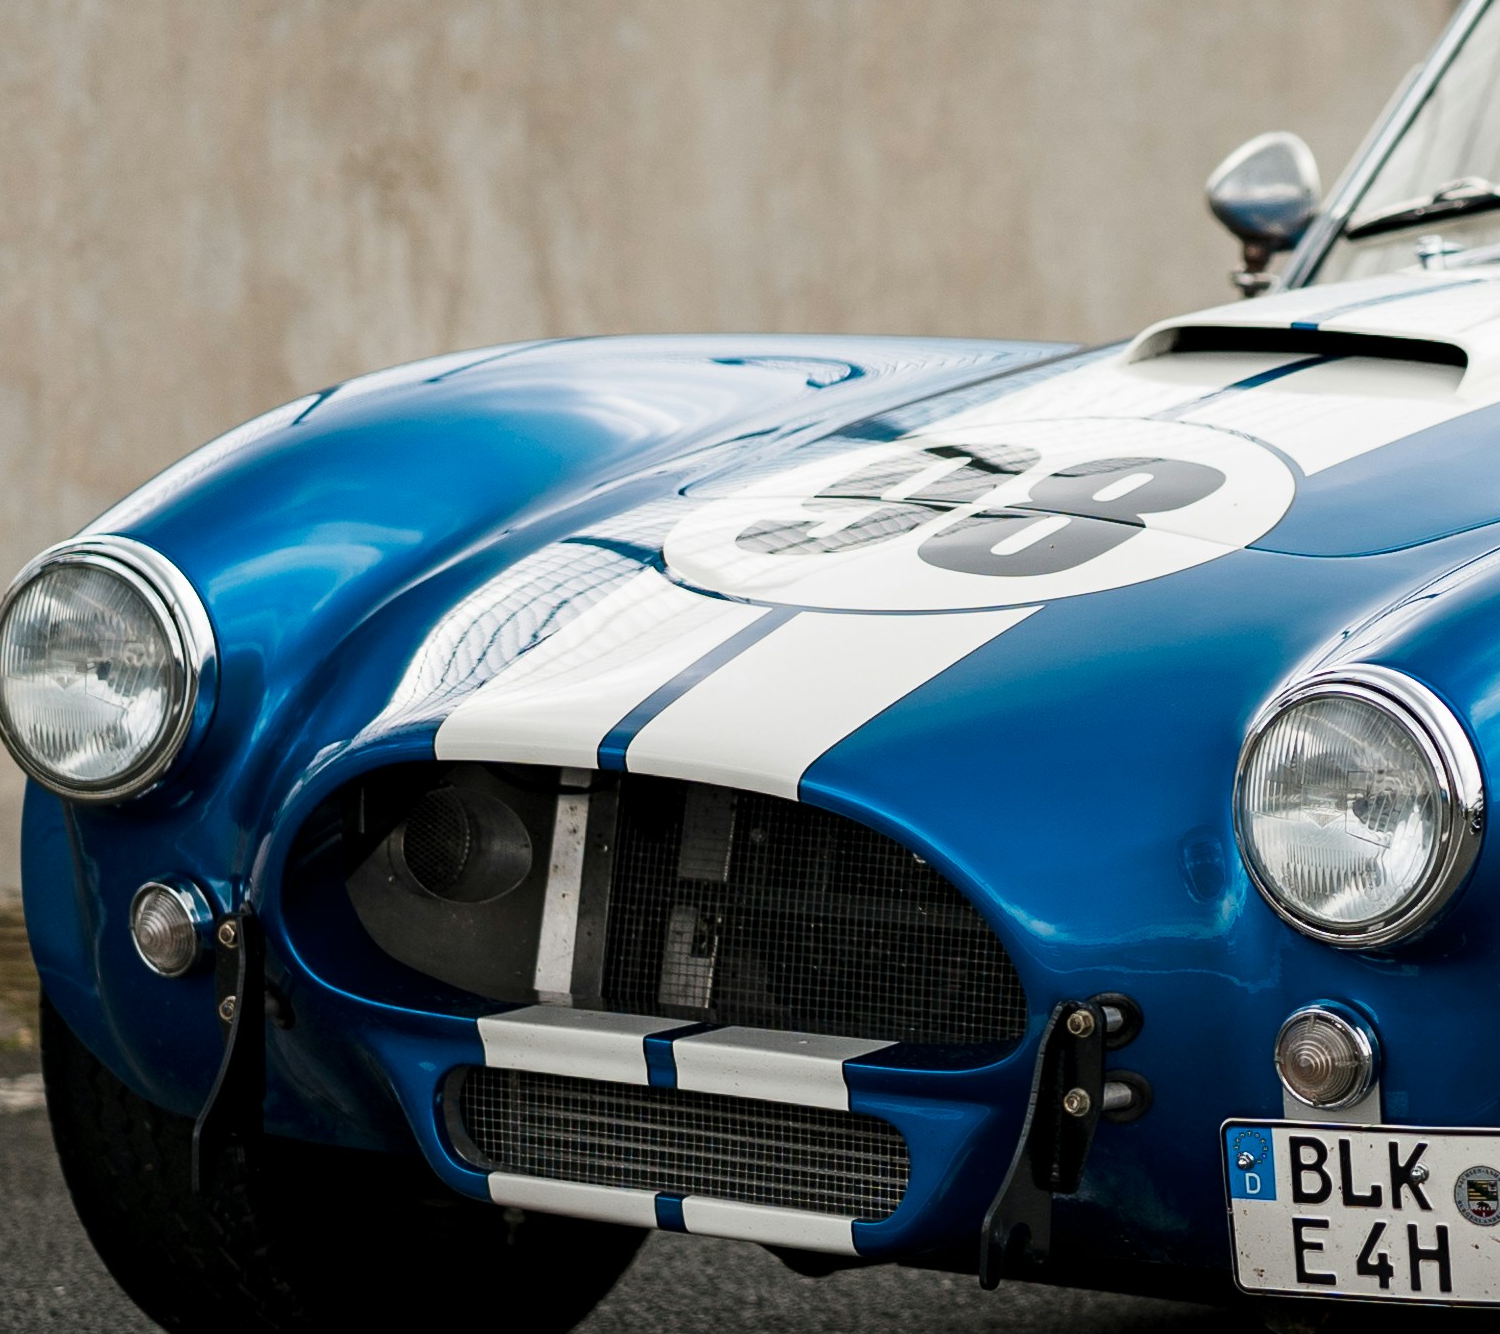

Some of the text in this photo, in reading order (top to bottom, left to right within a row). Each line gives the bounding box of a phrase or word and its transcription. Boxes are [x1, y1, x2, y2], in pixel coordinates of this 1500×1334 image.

[735, 443, 1227, 578] 98
[1245, 1172, 1261, 1194] D
[1289, 1135, 1432, 1210] BLK
[1292, 1217, 1453, 1292] E 4H
